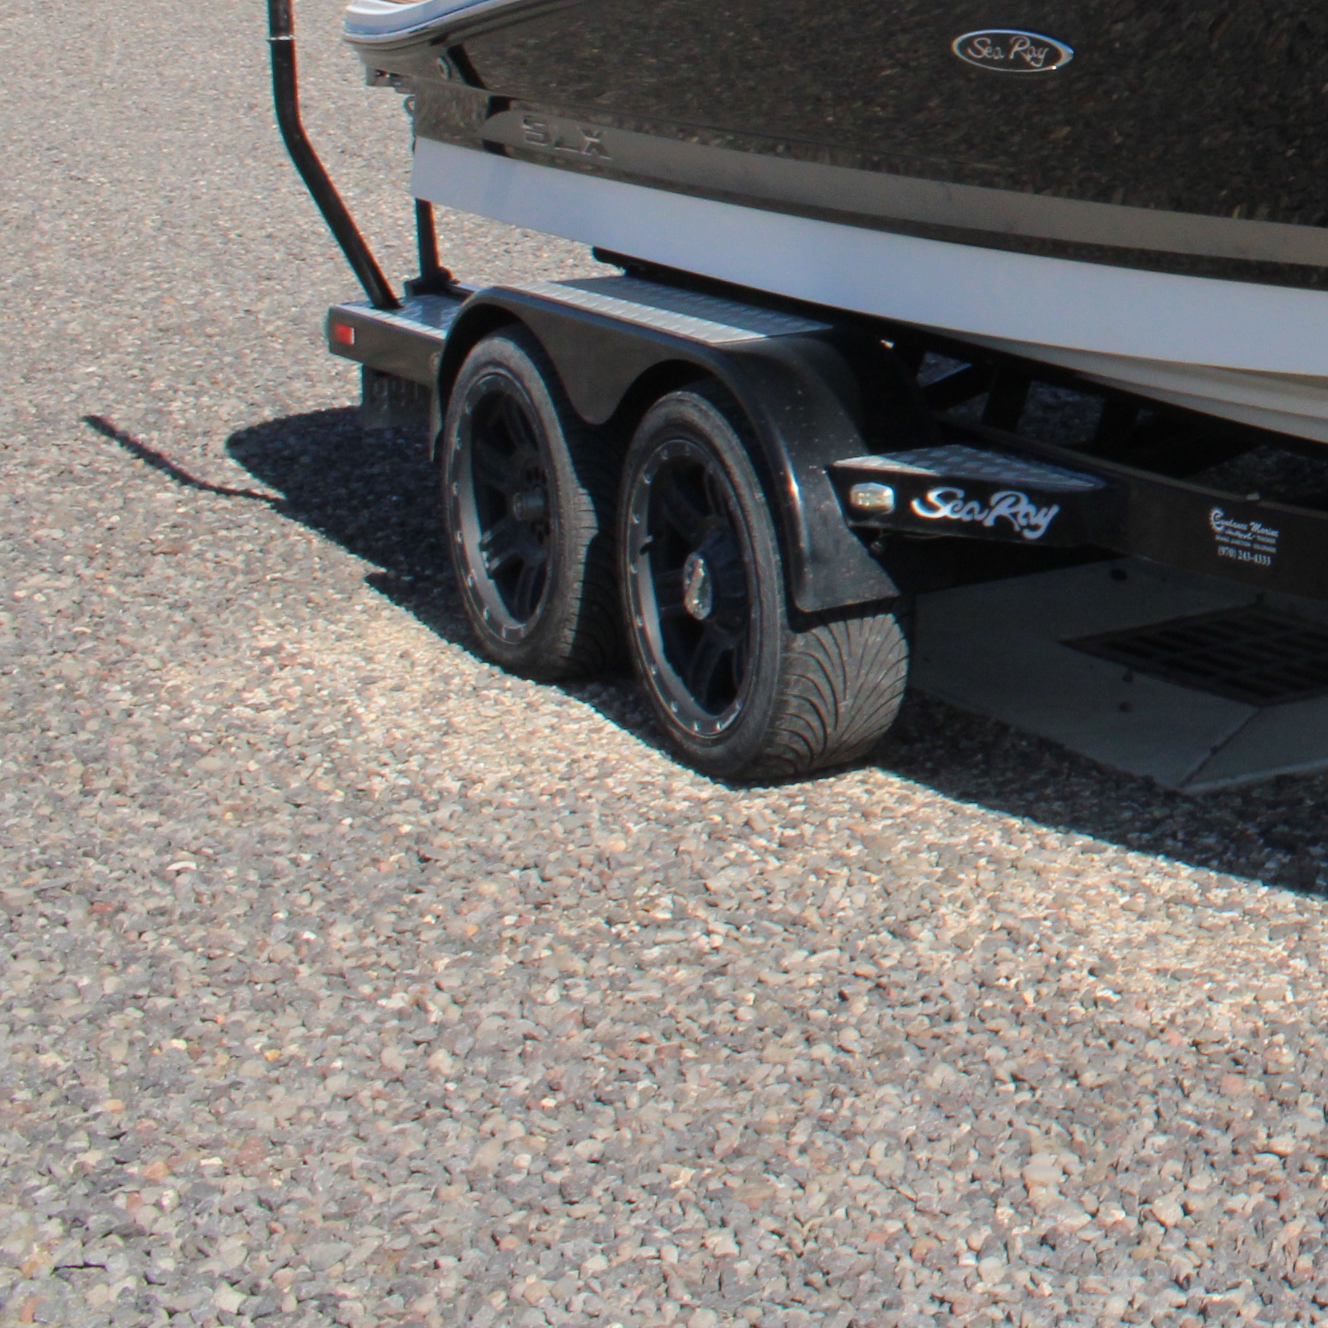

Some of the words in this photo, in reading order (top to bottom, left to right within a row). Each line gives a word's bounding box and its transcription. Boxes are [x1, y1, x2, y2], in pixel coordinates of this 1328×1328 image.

[966, 36, 1005, 60] Sea
[1009, 34, 1050, 68] Ray
[521, 115, 613, 161] SLX
[909, 485, 990, 522] Sea
[982, 490, 1062, 541] Ray
[1238, 549, 1272, 567] 243-4333
